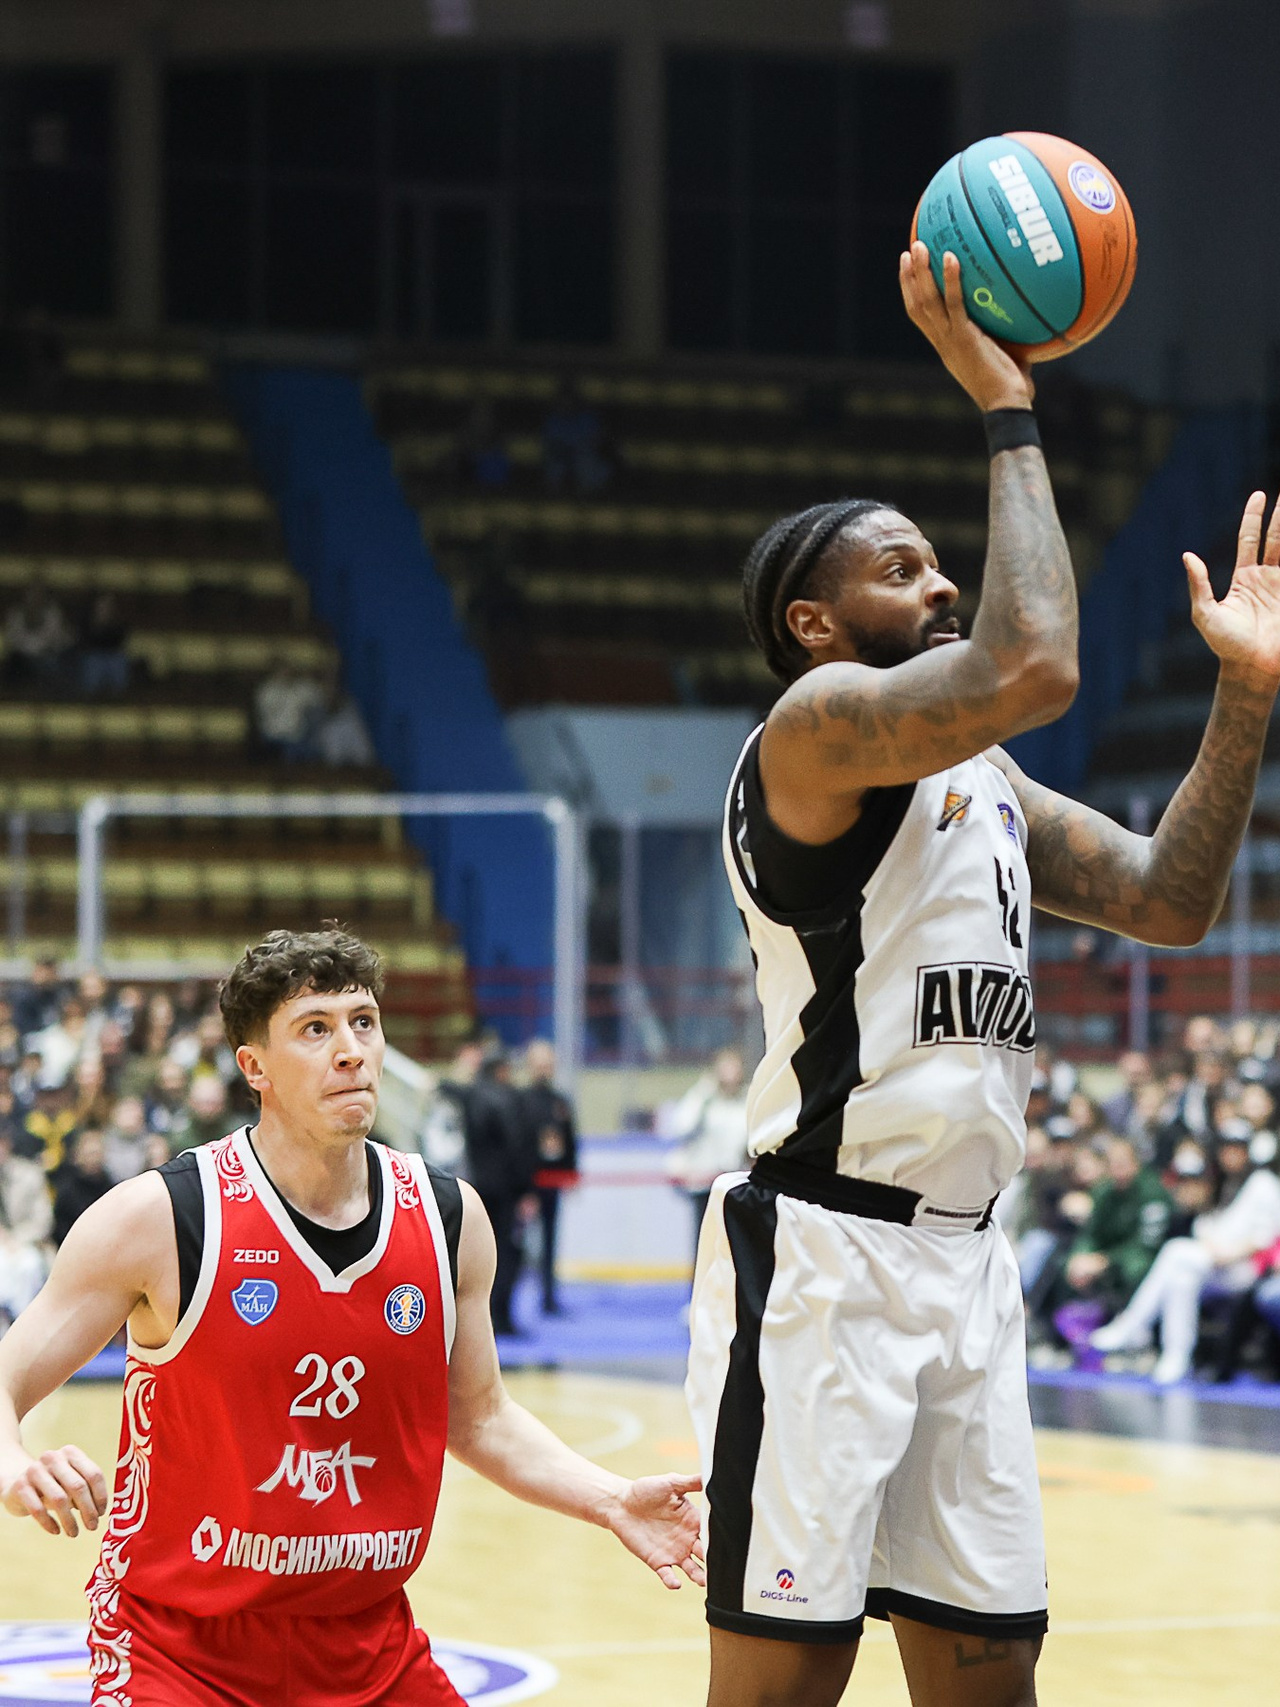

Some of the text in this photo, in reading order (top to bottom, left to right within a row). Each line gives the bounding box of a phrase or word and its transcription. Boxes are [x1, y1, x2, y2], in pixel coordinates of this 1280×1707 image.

[988, 154, 1064, 267] SIBUR
[233, 1248, 280, 1264] ZEDO
[289, 1352, 366, 1420] 28
[222, 1526, 423, 1576] МОСИНЖПРОЕКТ
